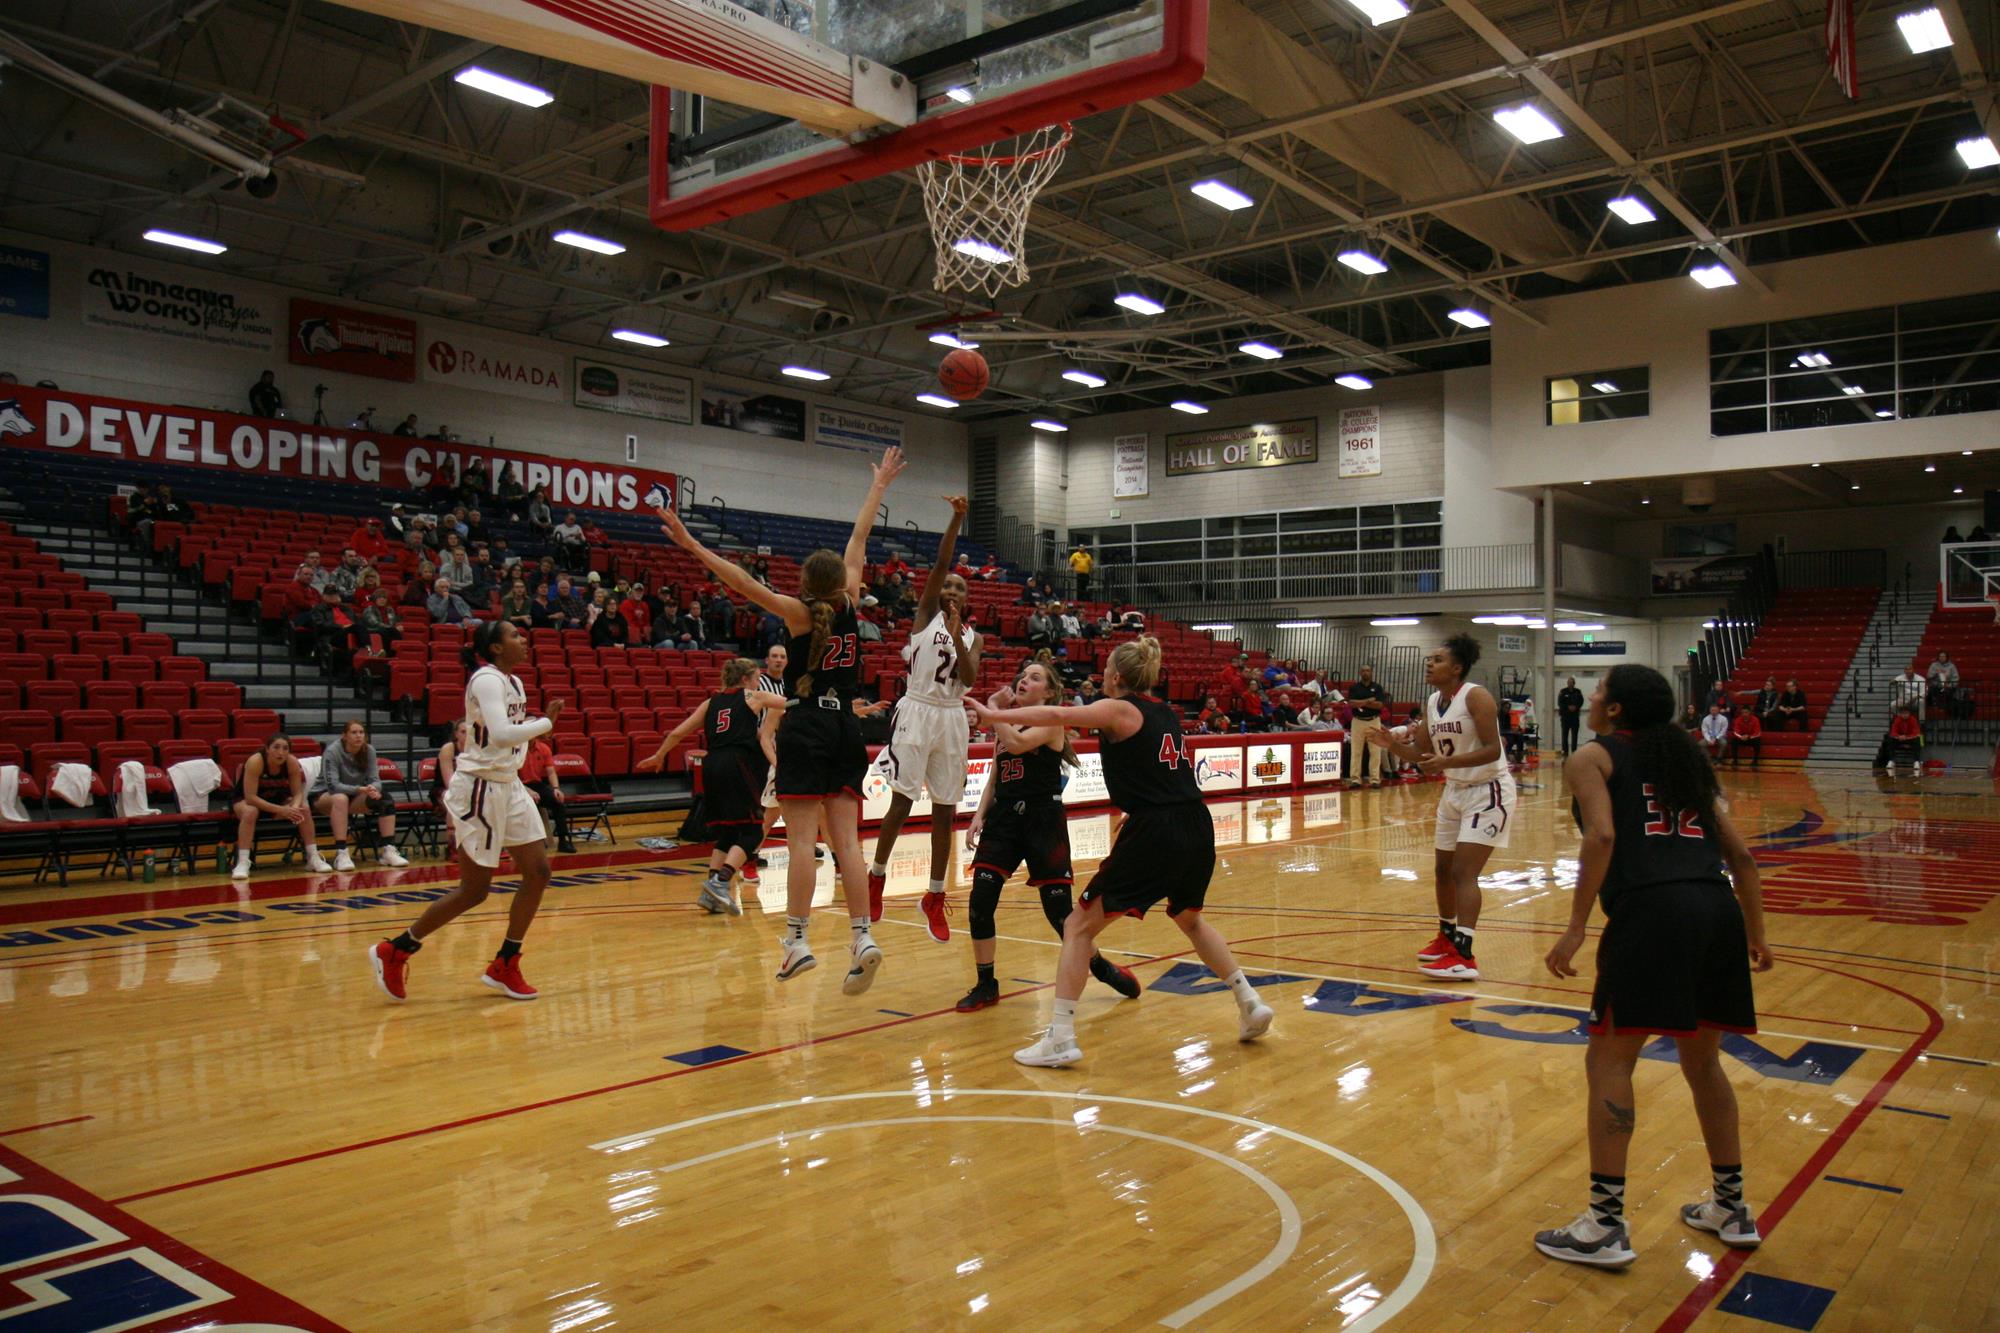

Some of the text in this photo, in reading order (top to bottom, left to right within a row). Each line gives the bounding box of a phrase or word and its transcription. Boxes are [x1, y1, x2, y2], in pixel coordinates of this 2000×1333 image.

[242, 323, 272, 335] UNION
[462, 351, 559, 389] RAMADA
[819, 412, 836, 425] The
[1344, 409, 1374, 418] NATIONAL
[1350, 416, 1379, 426] COLLEGE
[1341, 425, 1378, 436] CHAMPIONS
[1170, 438, 1312, 469] HALL OF FAME
[1345, 438, 1374, 451] 1961
[46, 399, 638, 511] DEVELOPING CHMPIONS
[822, 632, 857, 671] 23
[715, 708, 731, 733] 5
[1304, 750, 1340, 761] DAVE SOCIER
[1001, 758, 1025, 783] 25
[1305, 762, 1337, 774] PRESS ROW
[1642, 783, 1705, 838] 32
[0, 910, 265, 948] COUR
